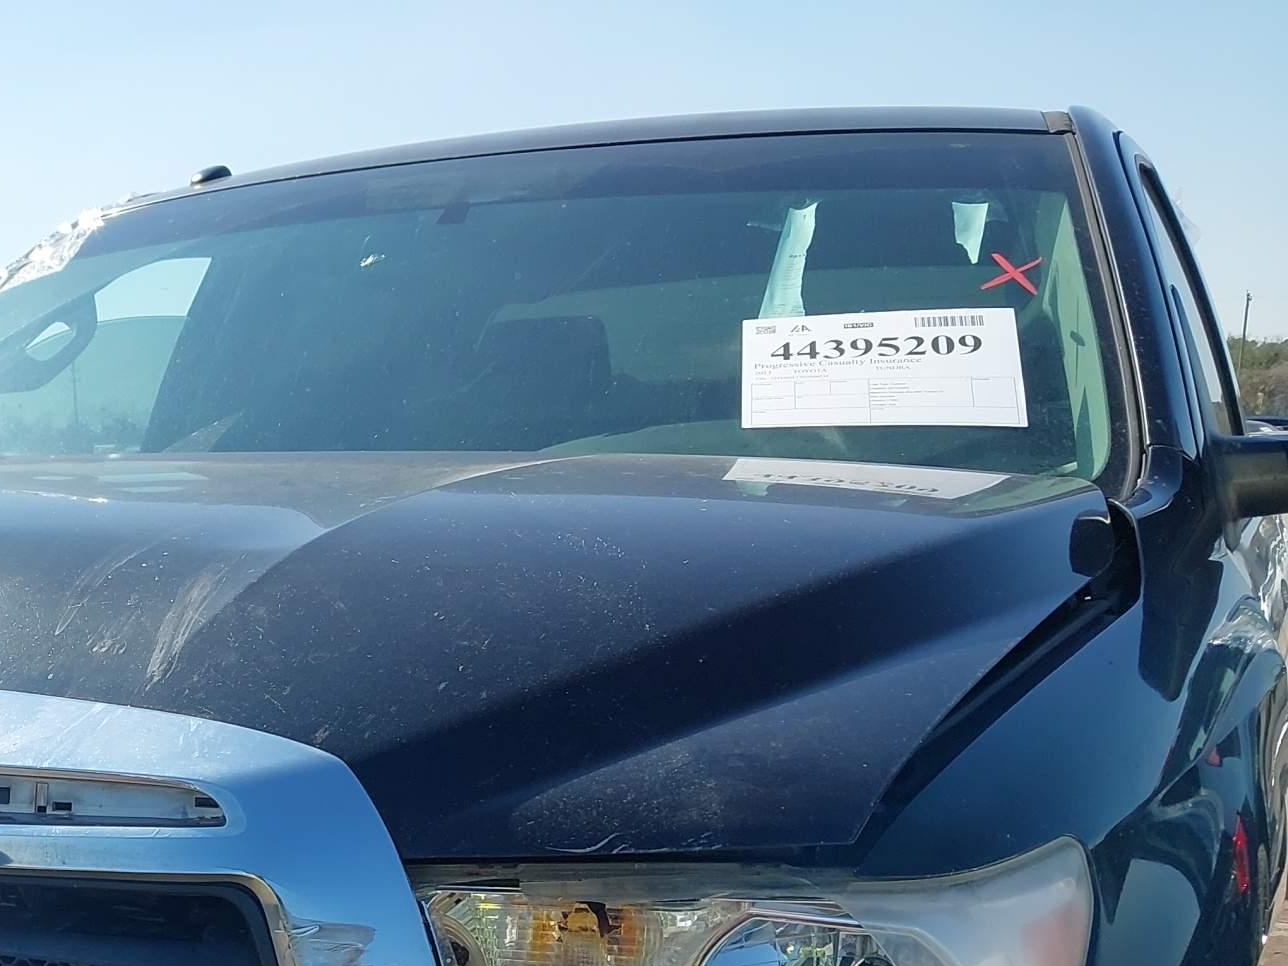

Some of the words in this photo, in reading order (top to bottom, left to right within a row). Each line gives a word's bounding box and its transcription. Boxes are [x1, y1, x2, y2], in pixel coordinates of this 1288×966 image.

[770, 334, 983, 361] 44395209
[754, 359, 816, 371] Progressive
[818, 357, 866, 368] Casualty
[869, 356, 923, 365] Insurance
